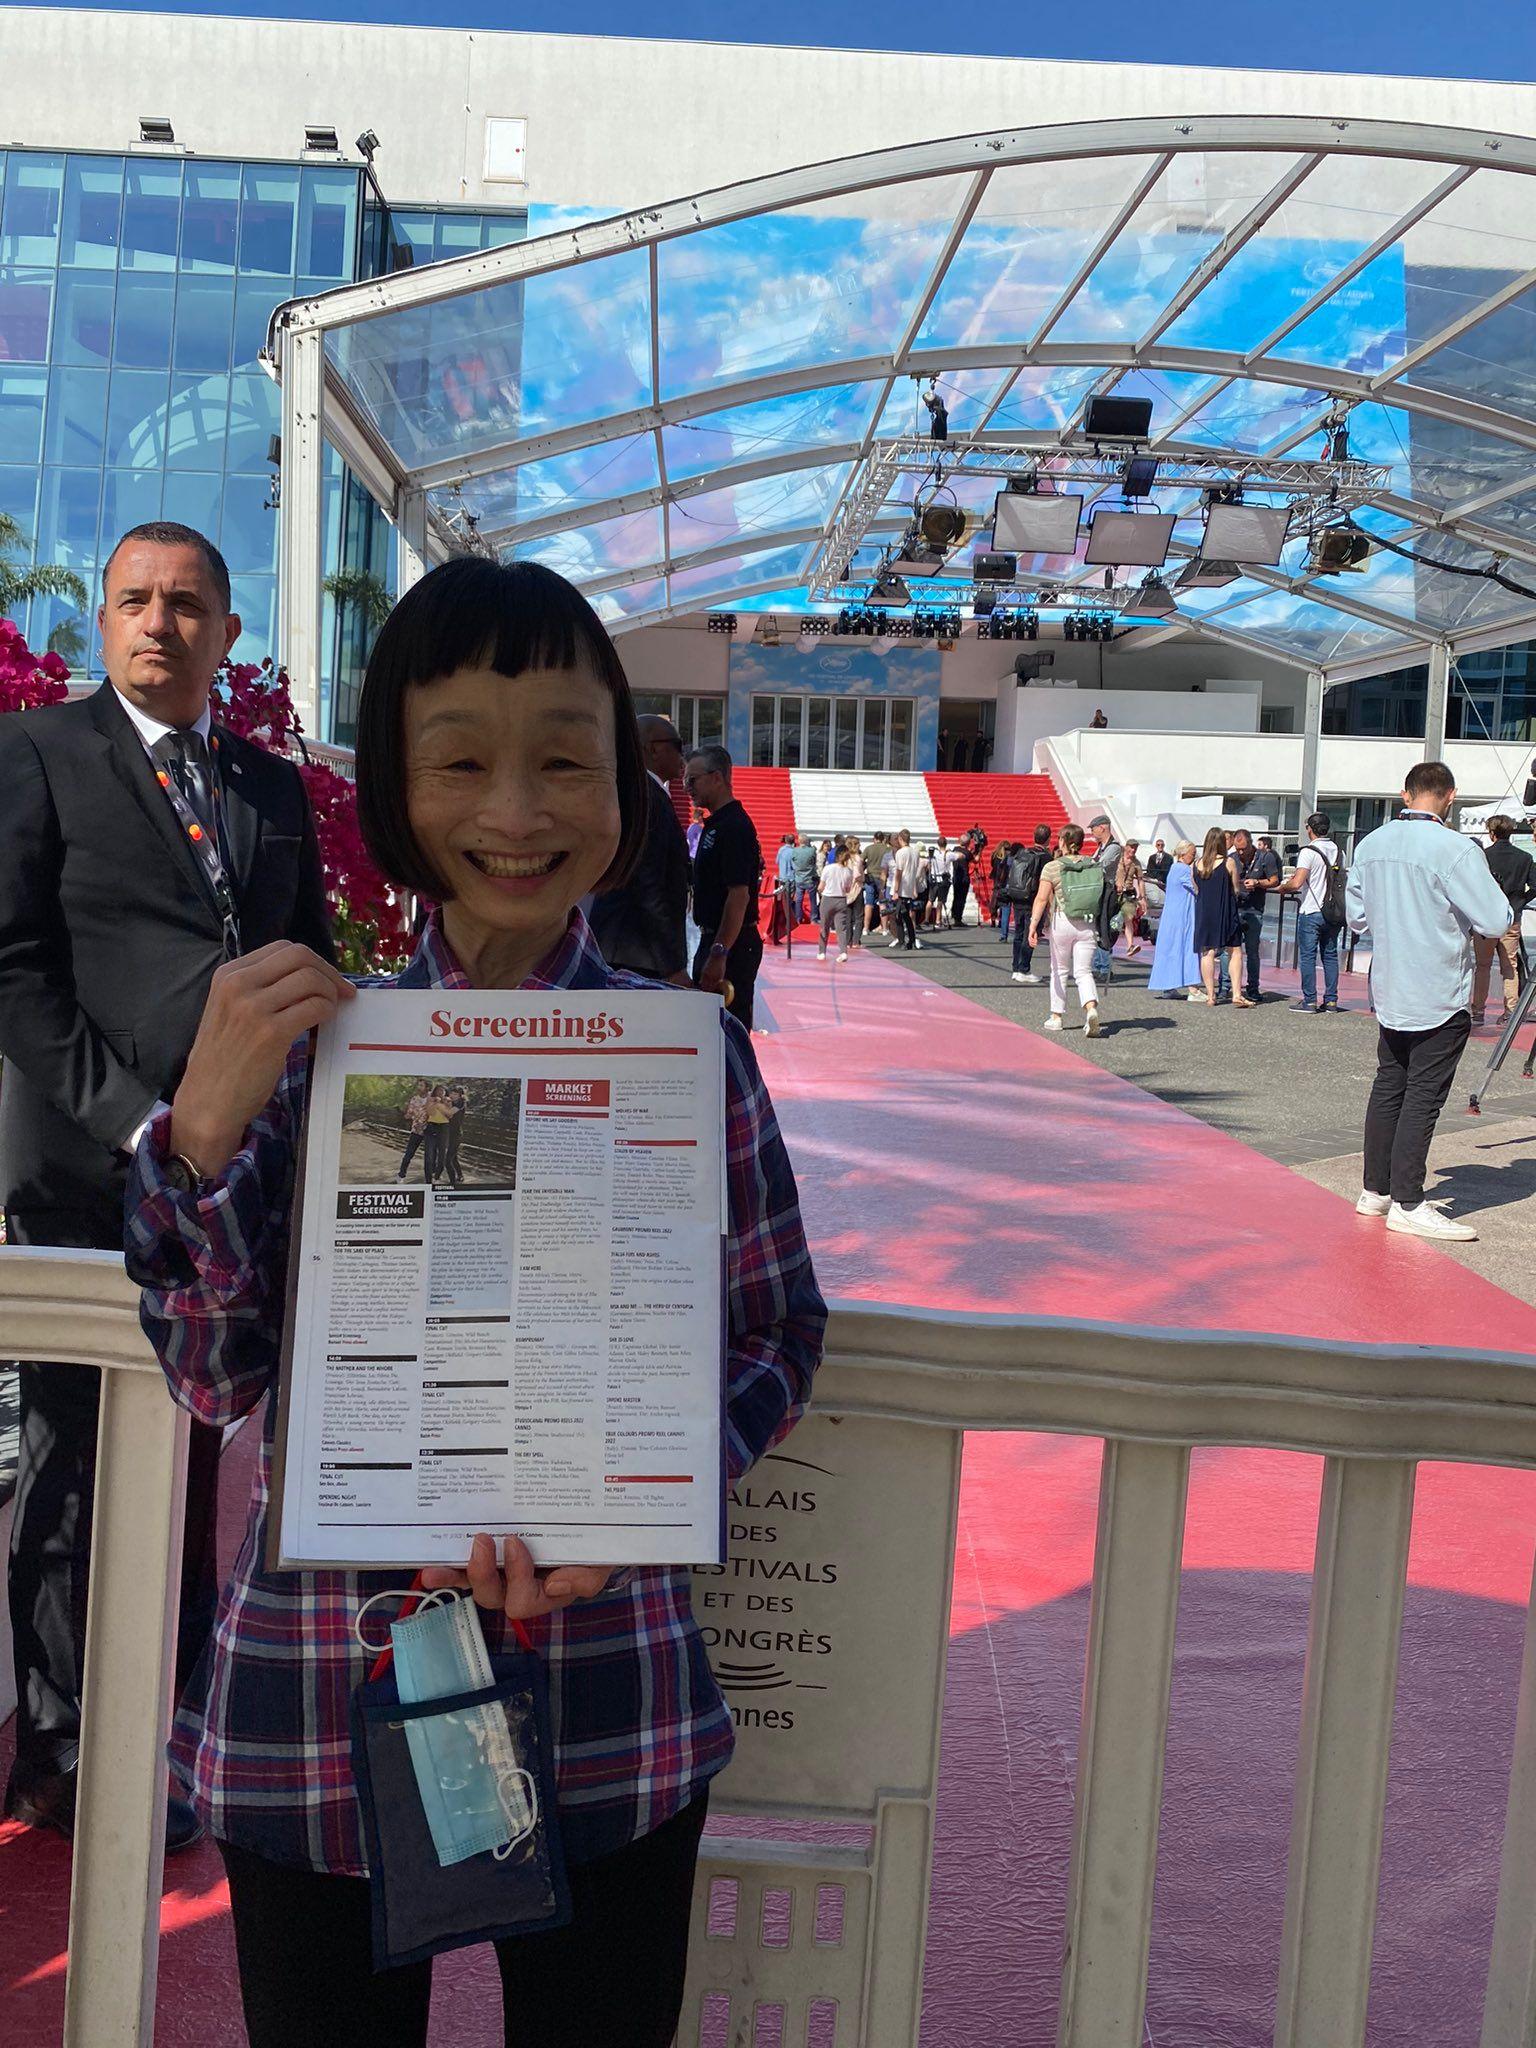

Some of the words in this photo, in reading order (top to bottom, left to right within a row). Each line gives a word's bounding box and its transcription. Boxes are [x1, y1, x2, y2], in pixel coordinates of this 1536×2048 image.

[429, 1009, 625, 1044] Screenings
[545, 1083, 593, 1094] MARKET
[545, 1094, 592, 1102] SCREENINGS
[349, 1194, 413, 1206] FESTIVAL
[352, 1206, 409, 1215] SCREENINGS
[728, 1489, 816, 1512] ALAIS
[730, 1524, 777, 1542] DES
[692, 1557, 837, 1584] ESTIVALS
[704, 1592, 735, 1608] ET
[747, 1595, 794, 1613] DES
[700, 1627, 832, 1655] ONGRÈS
[730, 1706, 794, 1730] nnes
